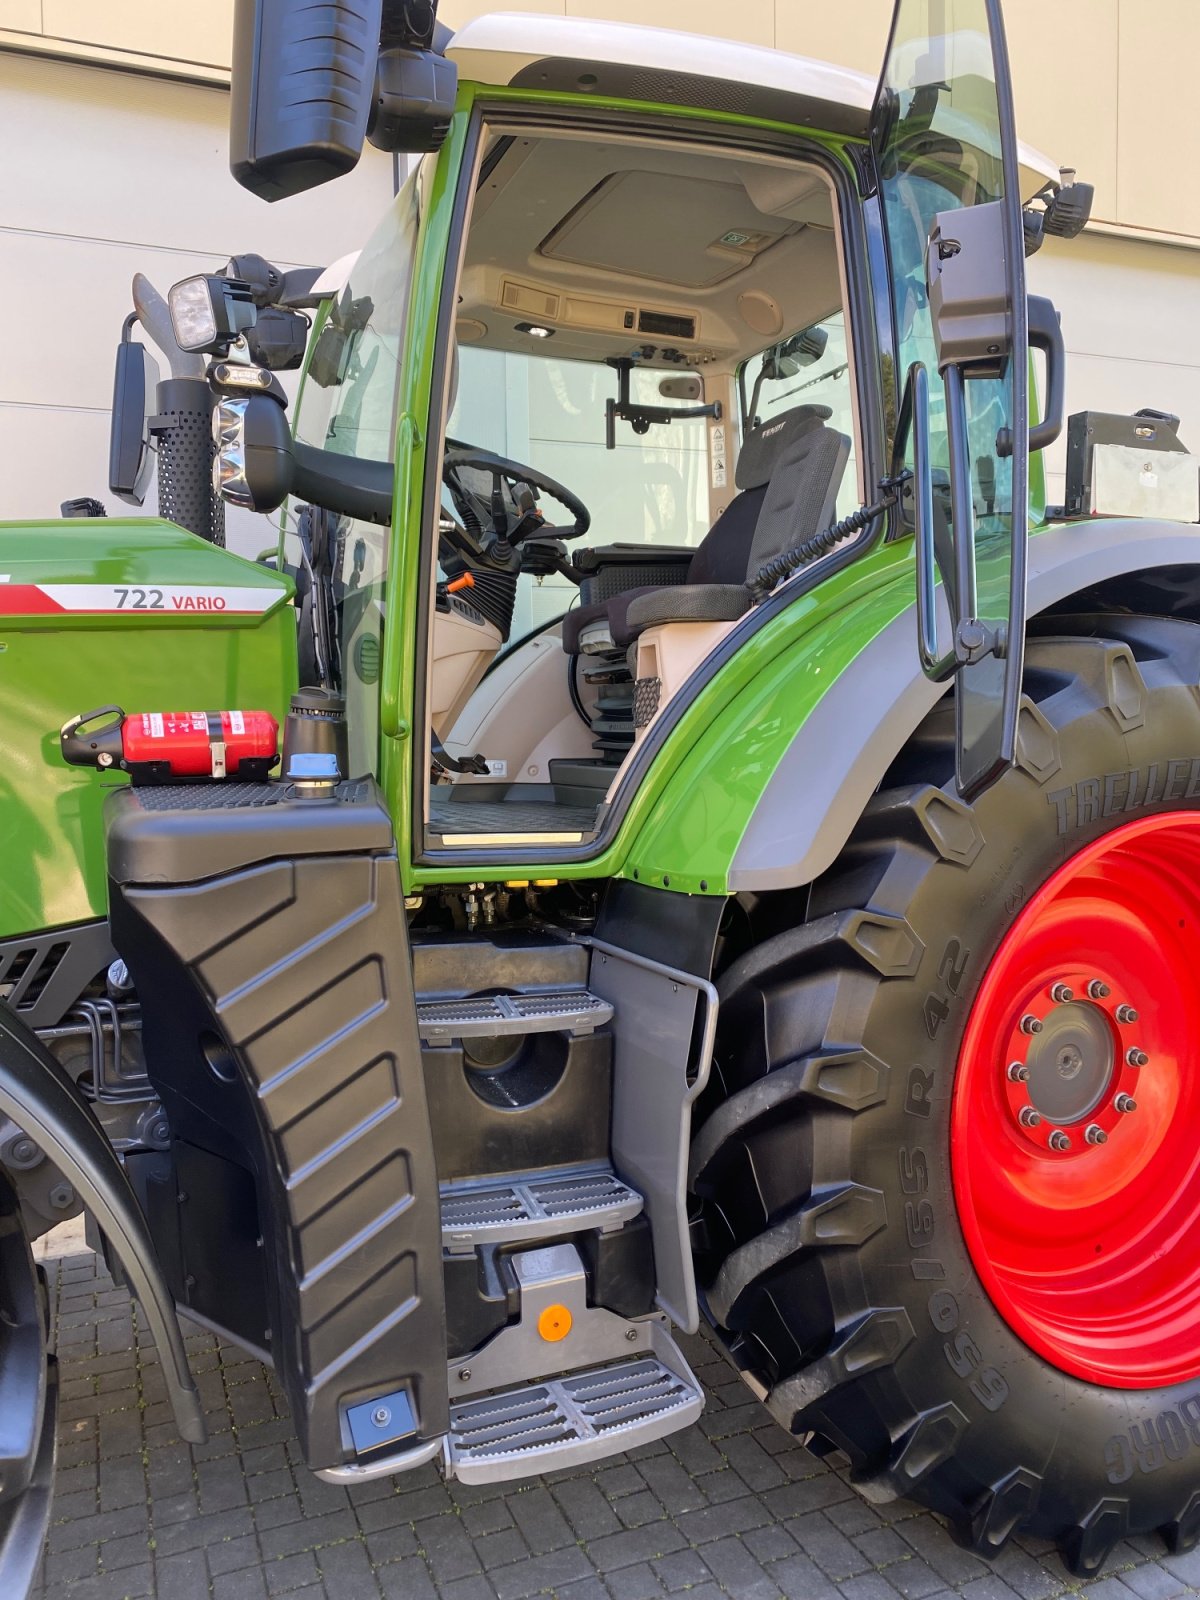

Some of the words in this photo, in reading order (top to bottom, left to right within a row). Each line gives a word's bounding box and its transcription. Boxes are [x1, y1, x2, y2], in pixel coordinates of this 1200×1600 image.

[761, 421, 786, 438] FENDT
[113, 589, 165, 609] 722
[172, 596, 226, 610] VARIO
[905, 1066, 935, 1119] R
[924, 938, 970, 1040] 42
